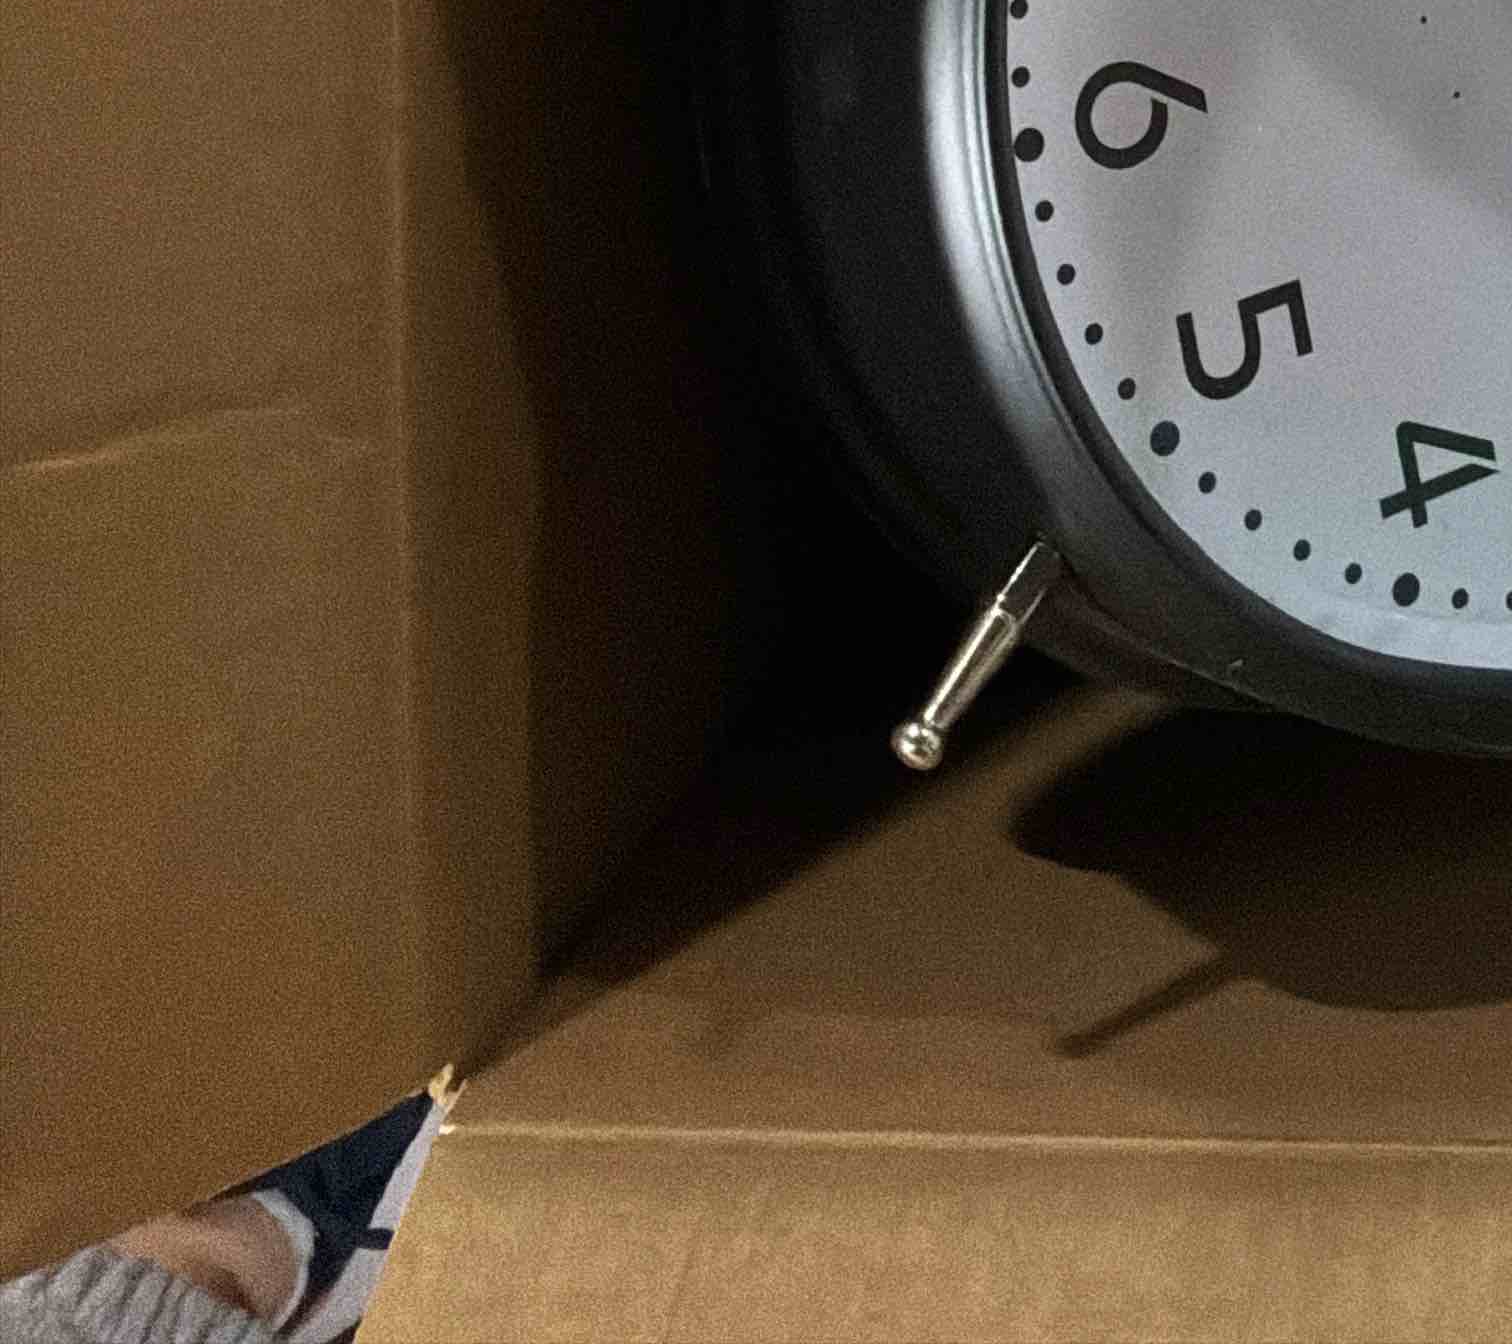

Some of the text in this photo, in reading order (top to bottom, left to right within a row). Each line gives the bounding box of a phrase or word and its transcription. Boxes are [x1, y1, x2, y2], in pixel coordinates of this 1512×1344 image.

[1074, 60, 1208, 171] 6
[1177, 279, 1313, 399] 5
[1378, 419, 1502, 528] 4
